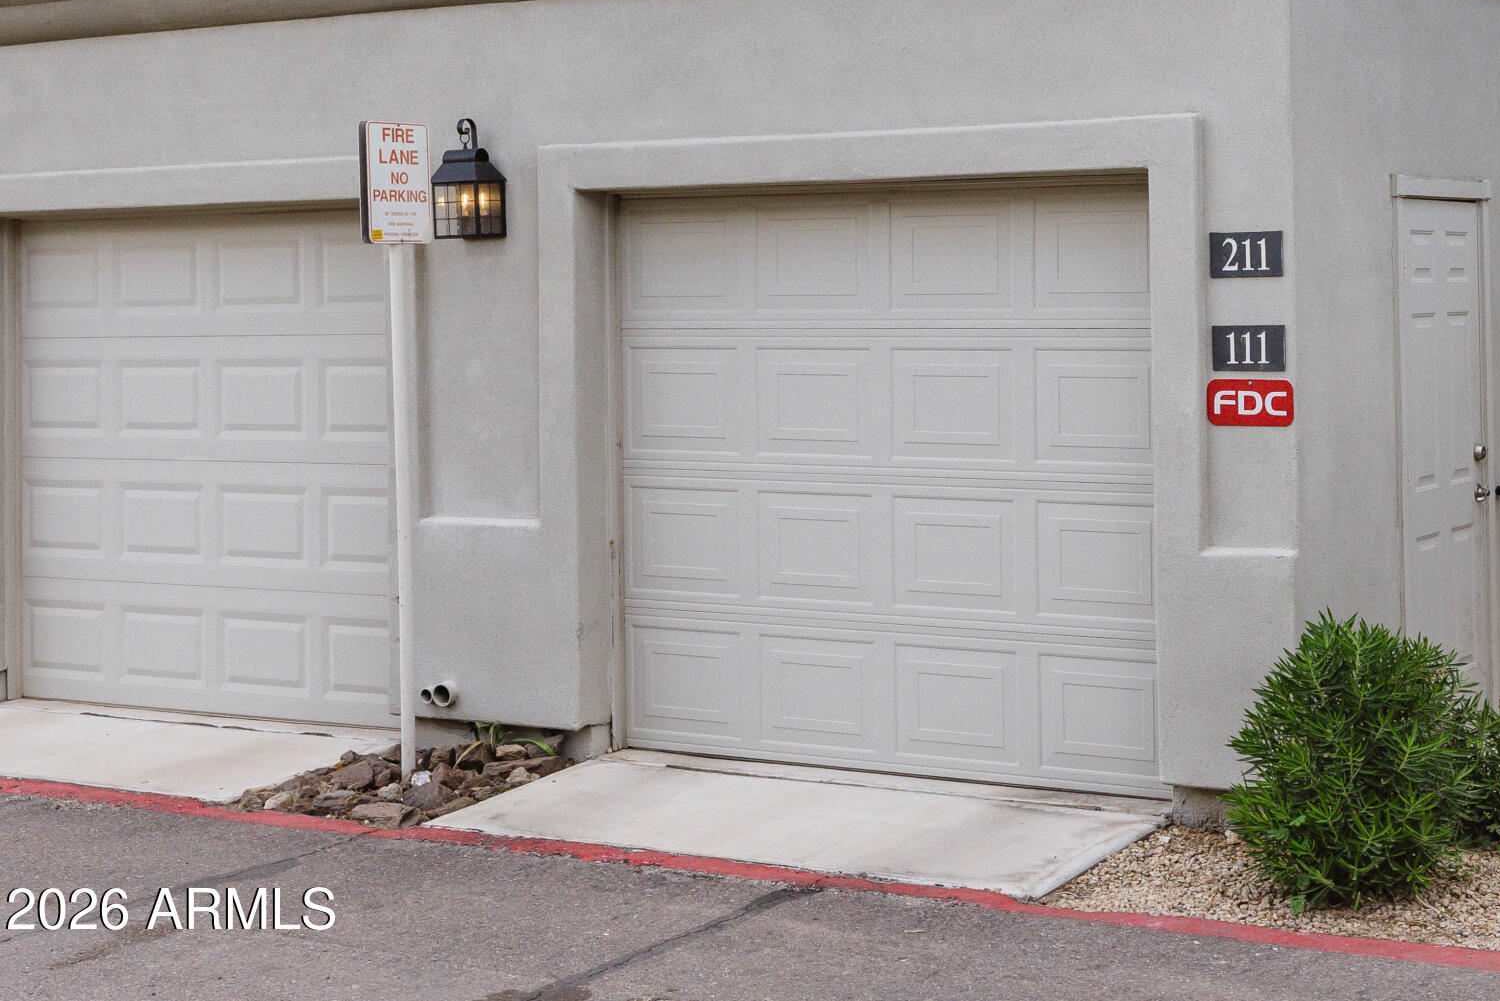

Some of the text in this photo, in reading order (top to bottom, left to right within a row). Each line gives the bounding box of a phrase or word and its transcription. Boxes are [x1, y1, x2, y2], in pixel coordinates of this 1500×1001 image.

[382, 127, 415, 144] FIRE
[378, 149, 419, 165] LANE
[390, 171, 409, 185] NO
[373, 189, 427, 203] PARKING
[1222, 237, 1271, 271] 211
[1225, 330, 1270, 365] 111
[1213, 390, 1288, 417] FDC
